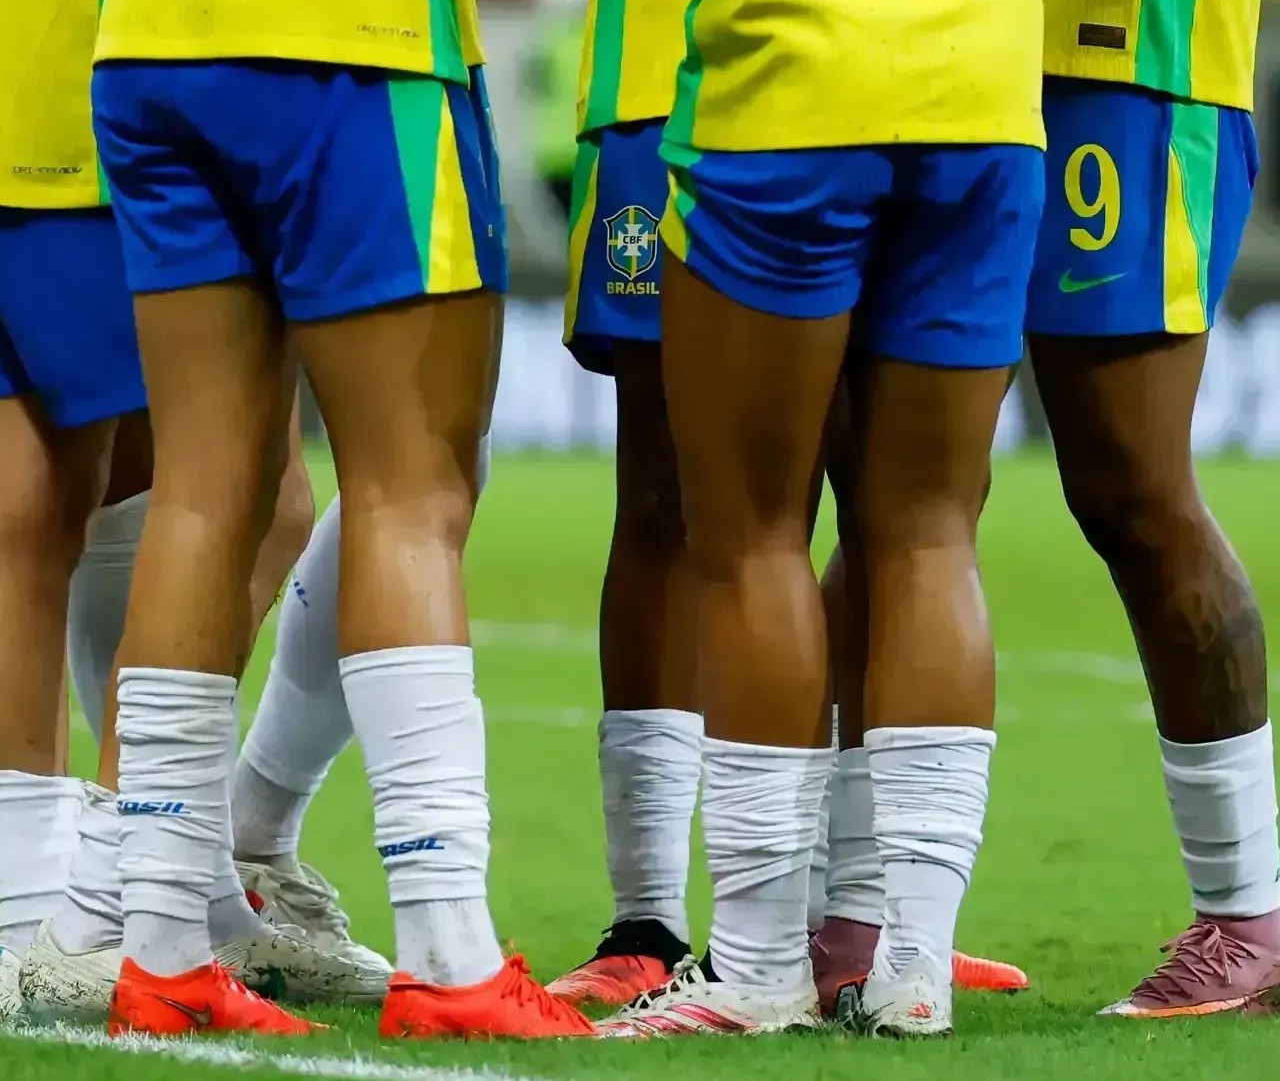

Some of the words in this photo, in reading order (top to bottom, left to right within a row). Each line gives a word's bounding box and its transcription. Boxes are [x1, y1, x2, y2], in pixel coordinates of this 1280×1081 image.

[1064, 143, 1121, 251] 9
[622, 235, 643, 244] CBF
[606, 281, 660, 295] BRASIL
